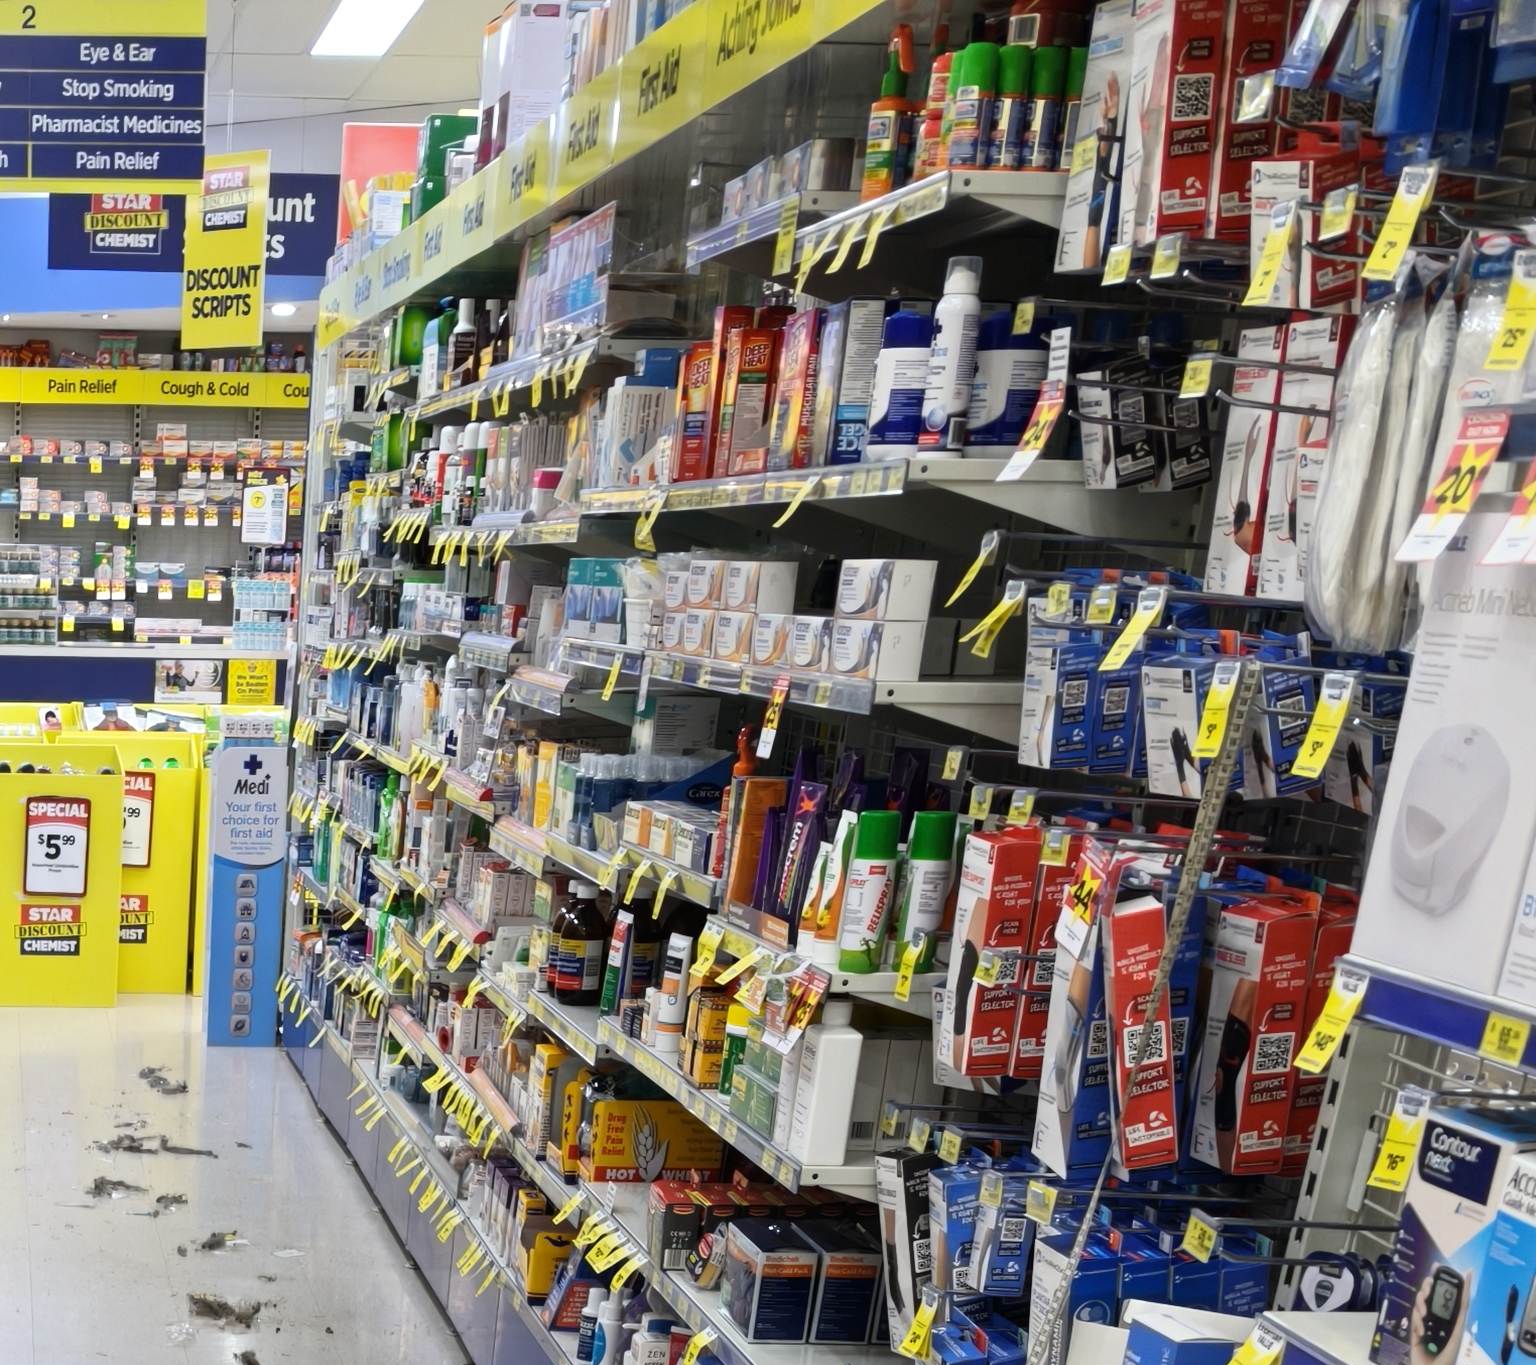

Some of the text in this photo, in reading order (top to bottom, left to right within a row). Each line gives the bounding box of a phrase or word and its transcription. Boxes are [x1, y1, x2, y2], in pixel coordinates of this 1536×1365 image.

[22, 5, 36, 28] 2
[80, 43, 156, 64] Eye & Ear
[638, 44, 682, 116] First Aid
[62, 79, 174, 101] Stop Smoking
[32, 114, 201, 134] Pharmacist Medicines
[567, 103, 600, 164] First Aid
[76, 152, 159, 170] Pain Relief
[210, 172, 243, 190] STAR
[510, 163, 523, 203] First
[102, 194, 151, 209] STAR
[202, 189, 252, 210] DISCOUNT
[90, 214, 162, 228] DISCOUNT
[205, 210, 245, 226] CHEMIST
[96, 233, 156, 248] CHEMIST
[186, 265, 260, 291] DISCOUNT
[192, 294, 250, 318] SCRIPTS
[746, 344, 769, 359] DEEP
[691, 357, 712, 377] DEEP
[744, 354, 768, 368] HEAT
[48, 380, 117, 394] Pain Relief
[690, 372, 710, 388] HEAT
[161, 381, 249, 396] Cough & Cold
[801, 354, 818, 426] MUSCULAR PAIN
[689, 789, 720, 797] Carex
[29, 803, 88, 818] SPECIAL
[226, 802, 276, 812] Your first
[222, 814, 279, 825] choice for
[230, 828, 272, 838] first aid
[867, 874, 892, 934] RELISPRAY
[29, 908, 72, 922] STAR
[19, 924, 84, 937] DISCOUNT
[24, 941, 76, 952] CHEMIST
[981, 1001, 1014, 1012] SELECTOR
[1253, 1078, 1285, 1090] SUPPORT
[608, 1113, 626, 1123] Drug
[607, 1125, 624, 1133] Free
[606, 1135, 623, 1144] Pain
[1431, 1128, 1482, 1162] Contour
[602, 1147, 625, 1155] Relief
[606, 1169, 636, 1179] HOT
[647, 1350, 666, 1358] ZEN
